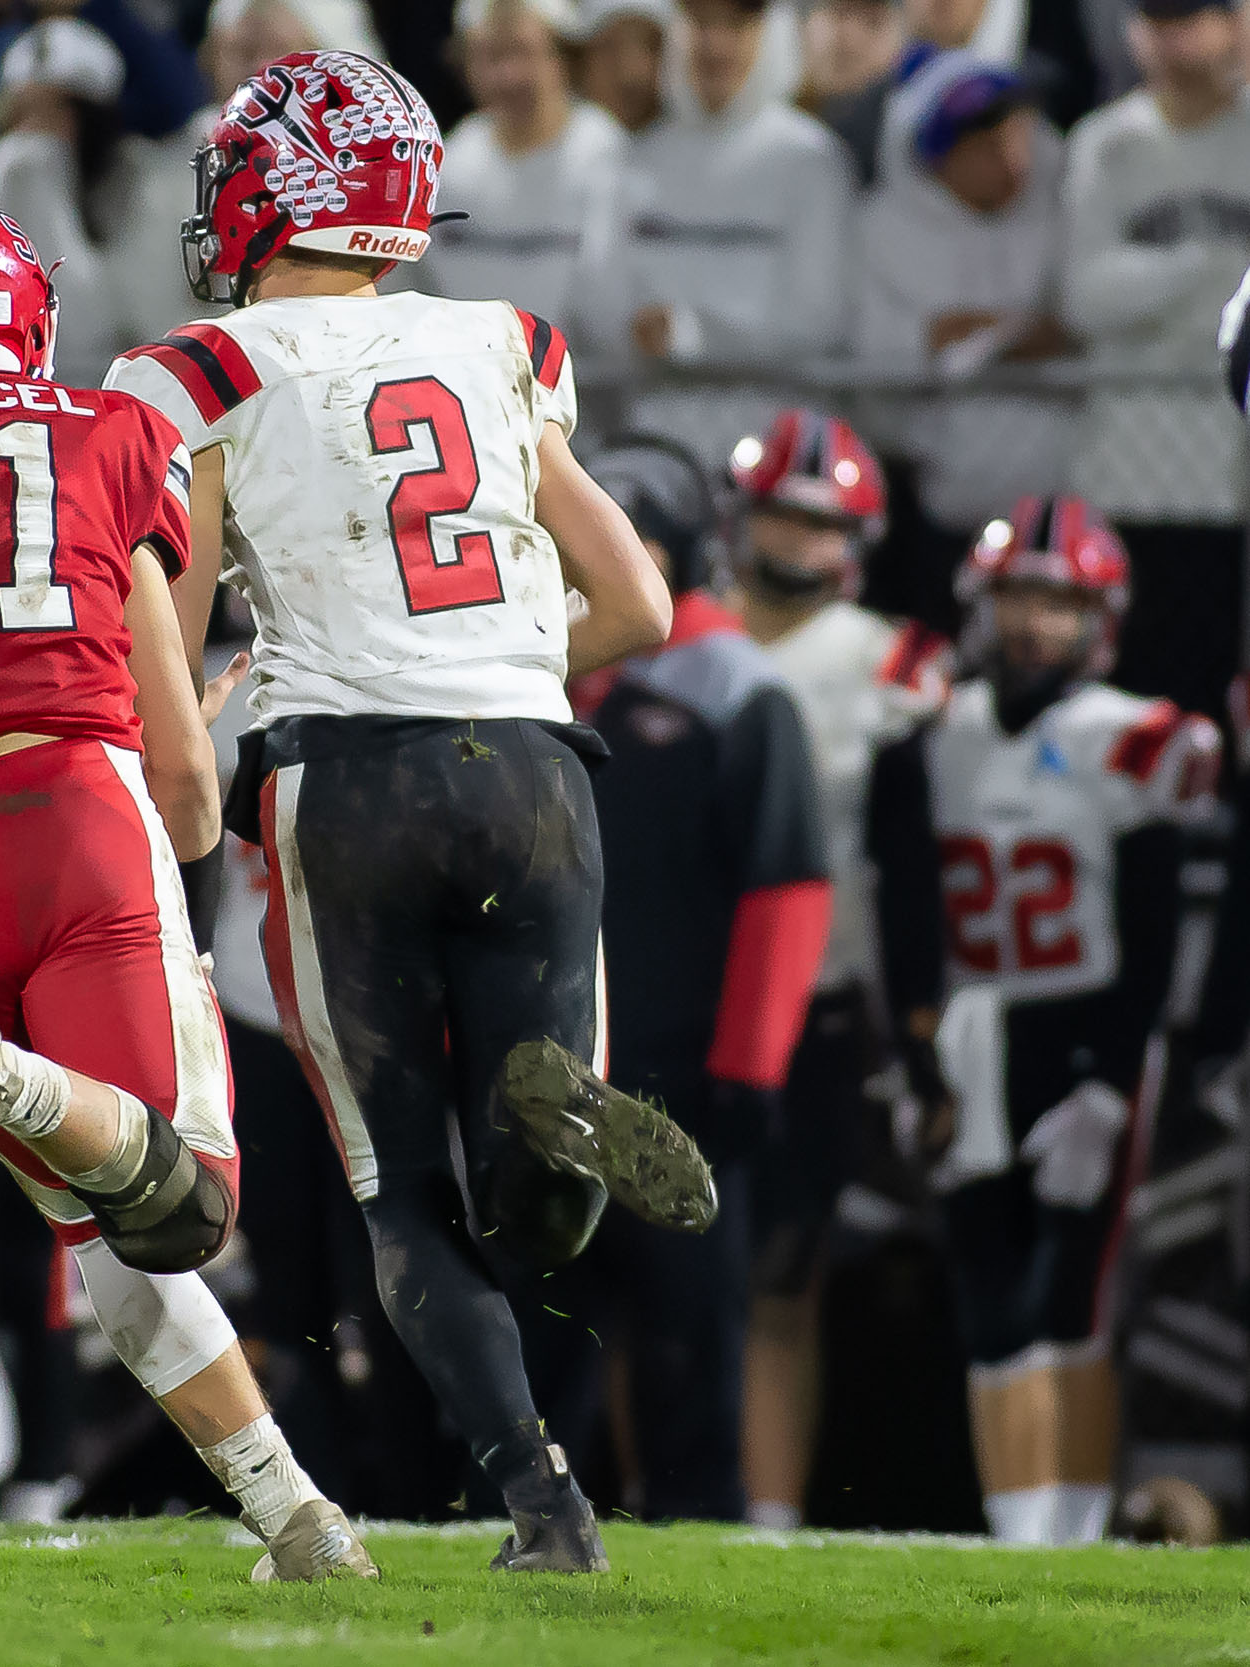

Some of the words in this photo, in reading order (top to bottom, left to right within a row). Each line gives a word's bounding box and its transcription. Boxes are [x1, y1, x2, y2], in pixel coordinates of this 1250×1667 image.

[347, 230, 428, 259] Riddell
[366, 375, 506, 617] 2
[938, 834, 1082, 970] 22
